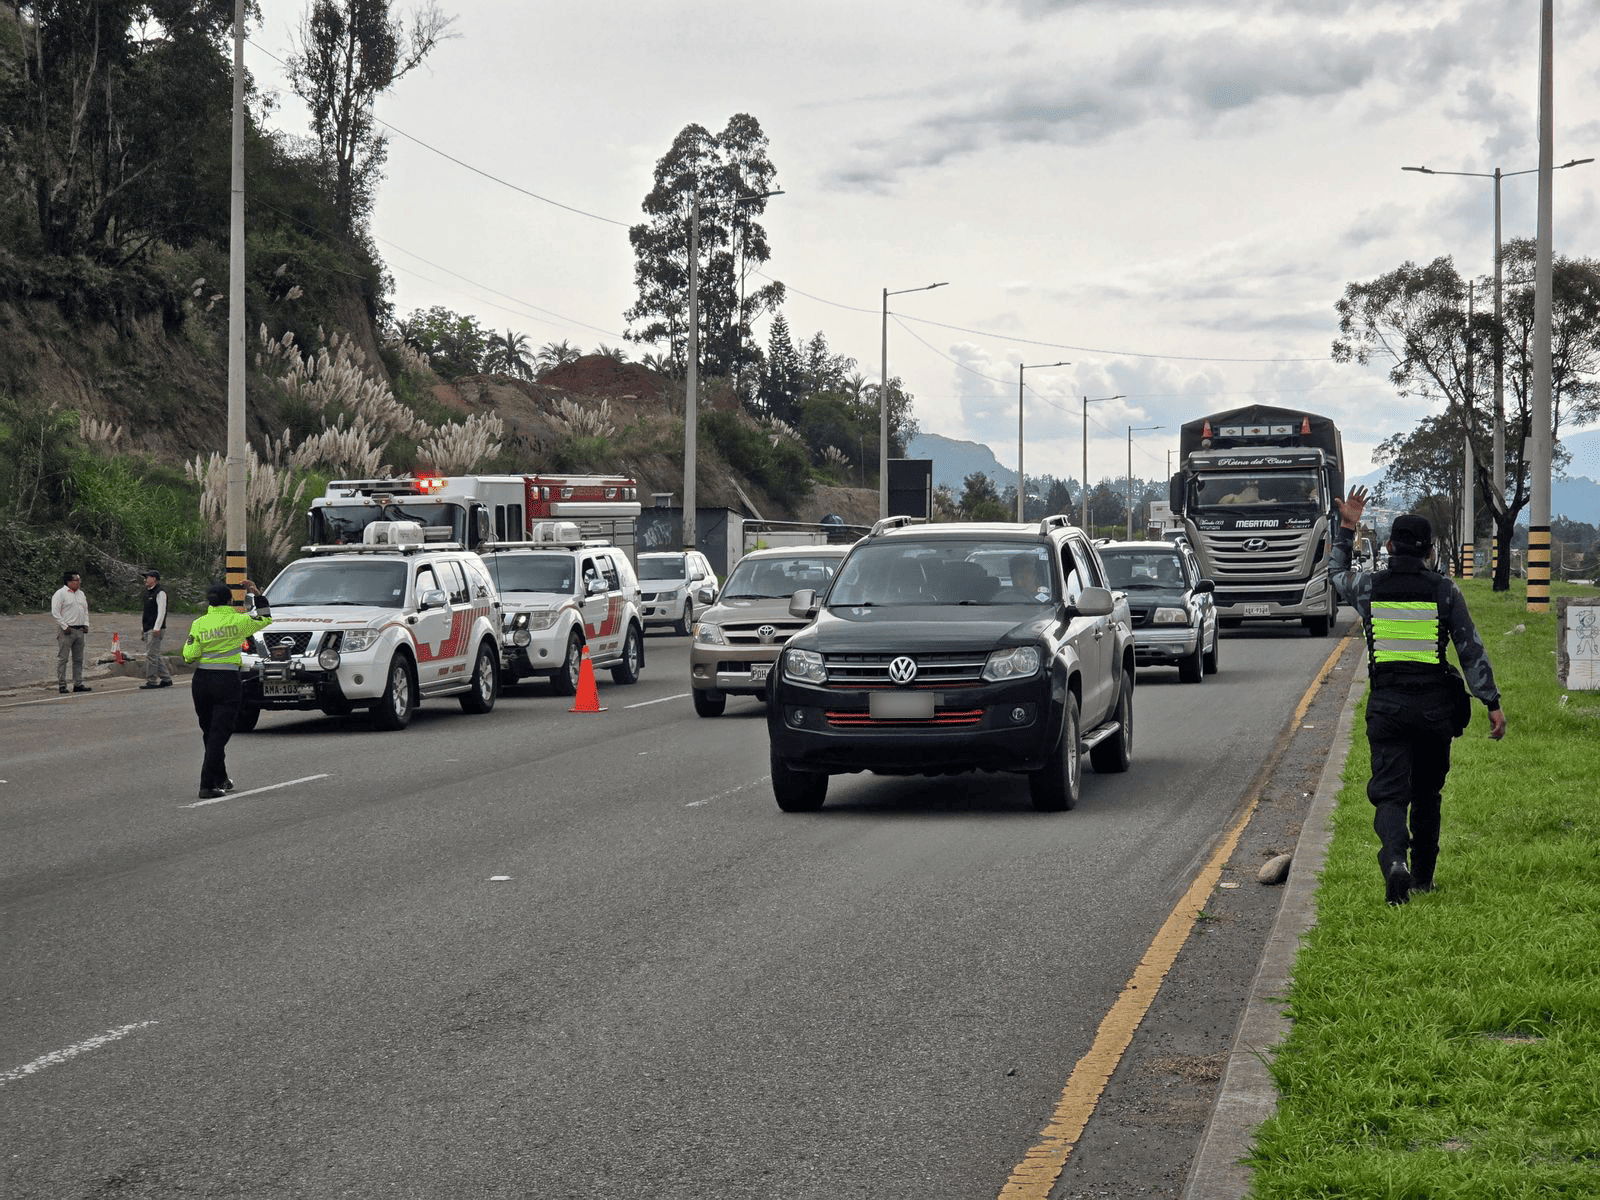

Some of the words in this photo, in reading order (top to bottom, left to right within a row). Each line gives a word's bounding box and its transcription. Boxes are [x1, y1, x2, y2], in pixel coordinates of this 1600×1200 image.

[1235, 519, 1279, 528] MEGATRON
[198, 625, 239, 641] TRANSITO
[264, 684, 303, 694] AMA-103
